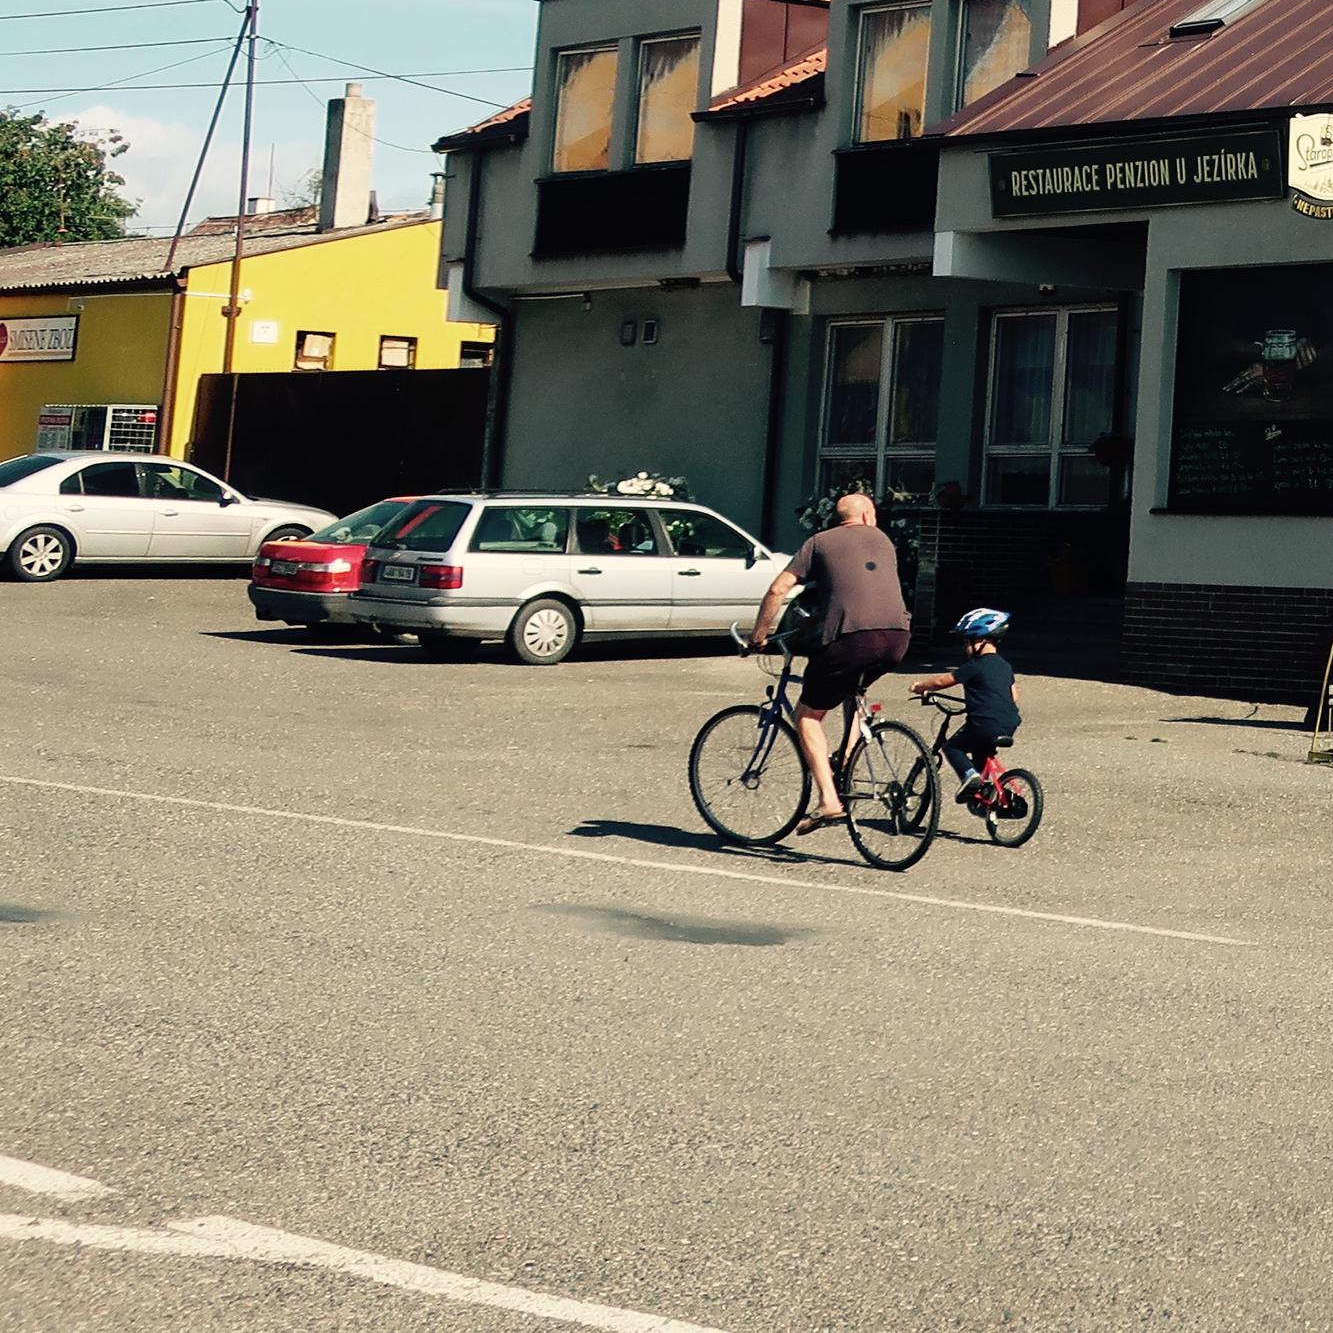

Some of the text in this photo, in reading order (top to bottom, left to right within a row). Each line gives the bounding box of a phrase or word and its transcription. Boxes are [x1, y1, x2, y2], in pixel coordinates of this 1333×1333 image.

[1011, 148, 1258, 197] RESTAURACE PENZION U JEZÍRKA
